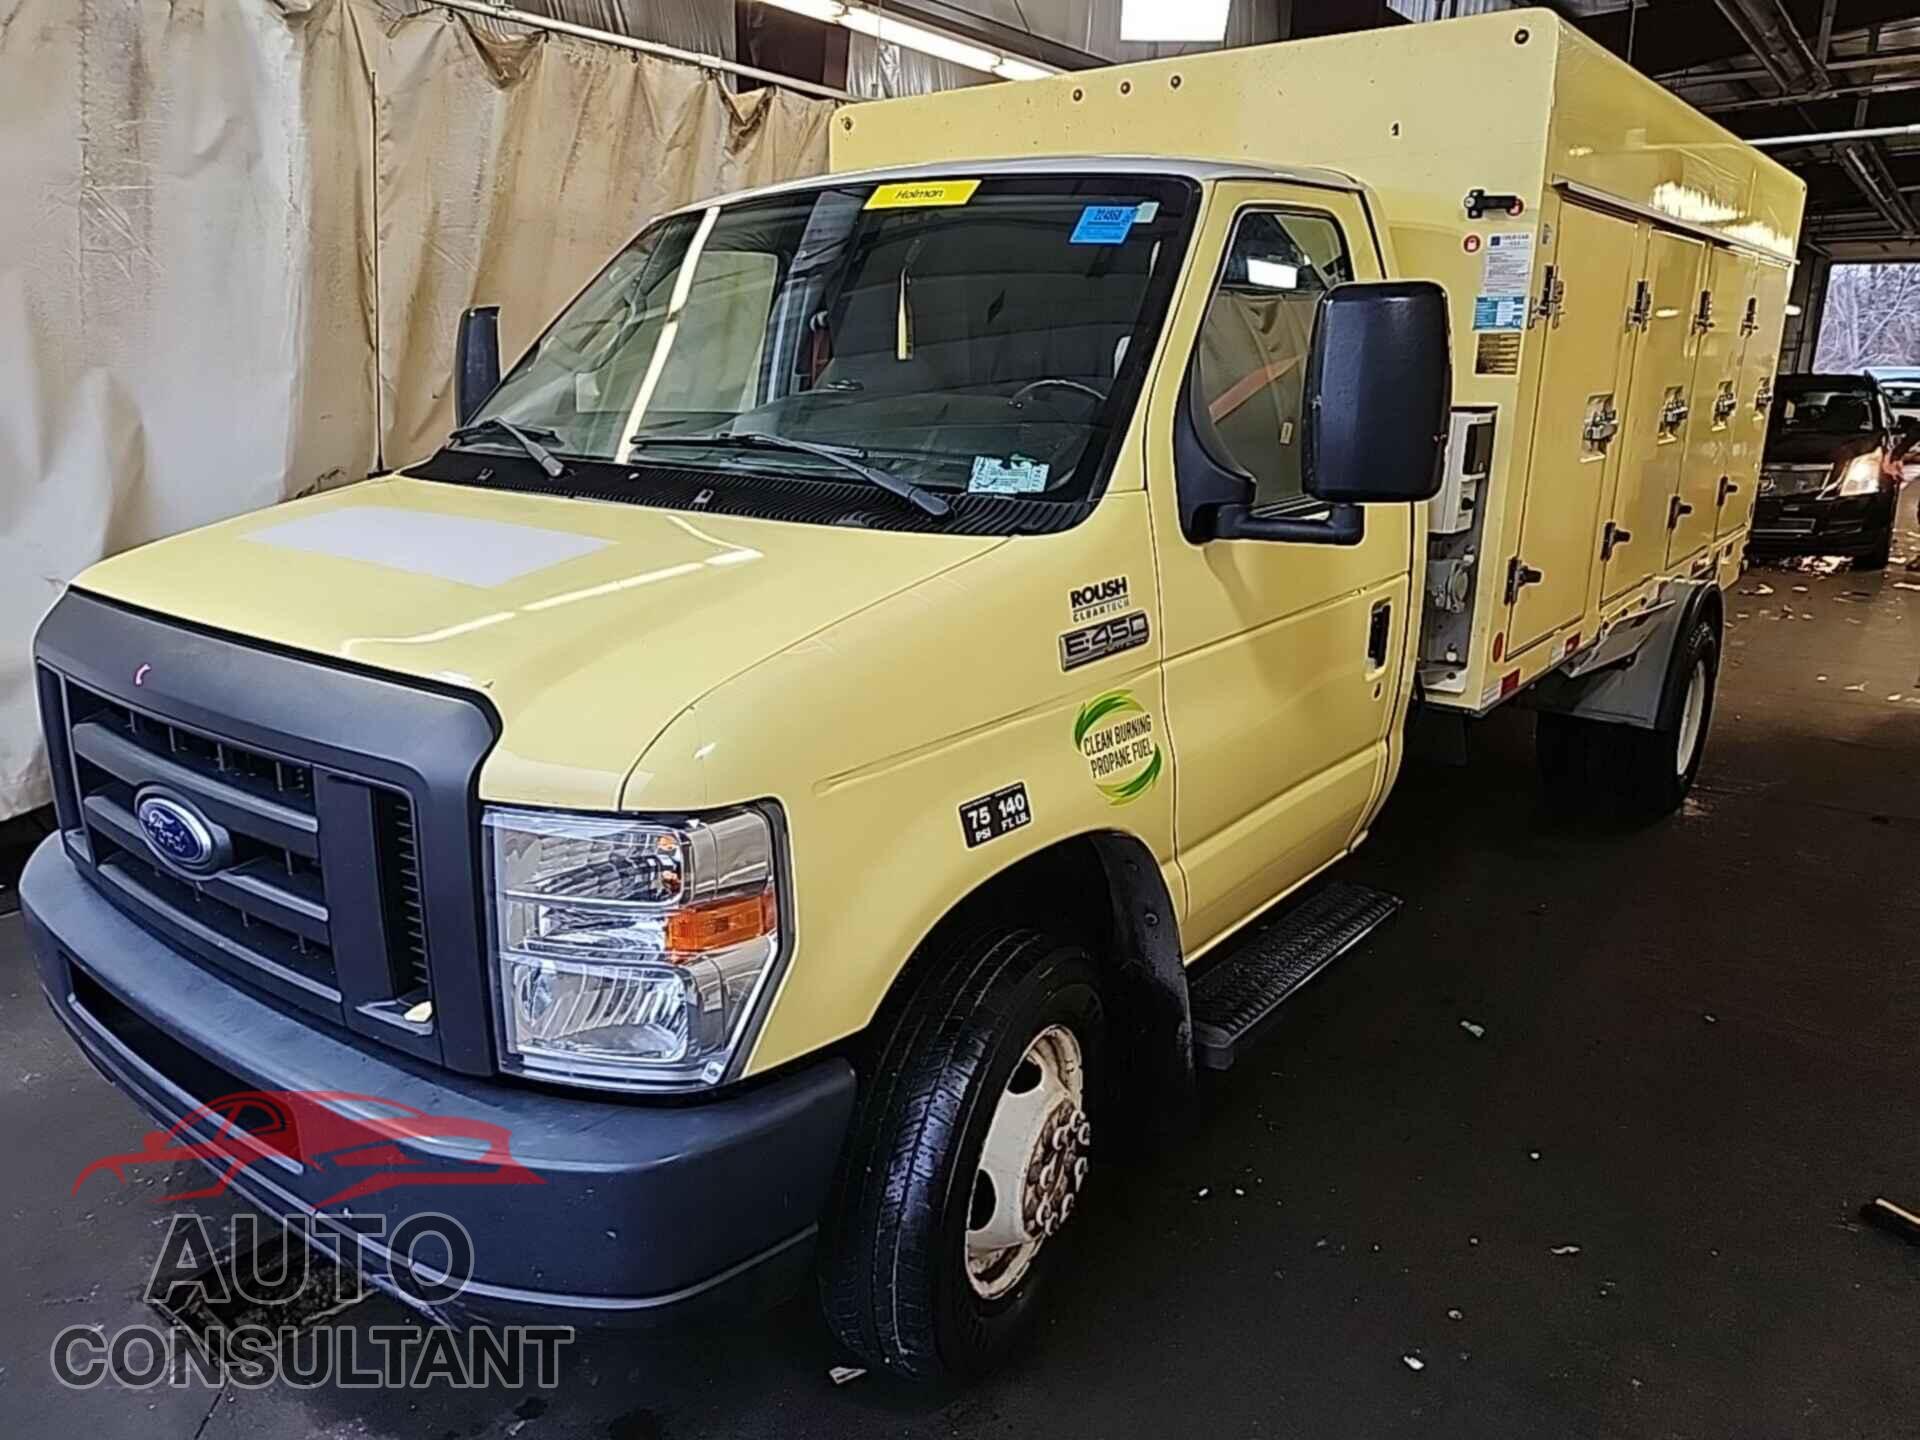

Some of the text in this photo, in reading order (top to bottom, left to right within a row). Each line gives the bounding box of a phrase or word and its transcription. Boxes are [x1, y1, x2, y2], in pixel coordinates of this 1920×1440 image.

[895, 189, 944, 199] Holman
[1070, 576, 1127, 608] ROUSH
[1073, 599, 1129, 622] CLEANTECH
[1083, 714, 1152, 757] CLEAN BURNING
[1090, 737, 1153, 778] PROPANE FUEL
[967, 806, 991, 829] 75
[998, 793, 1025, 818] 140
[975, 826, 992, 842] PSI
